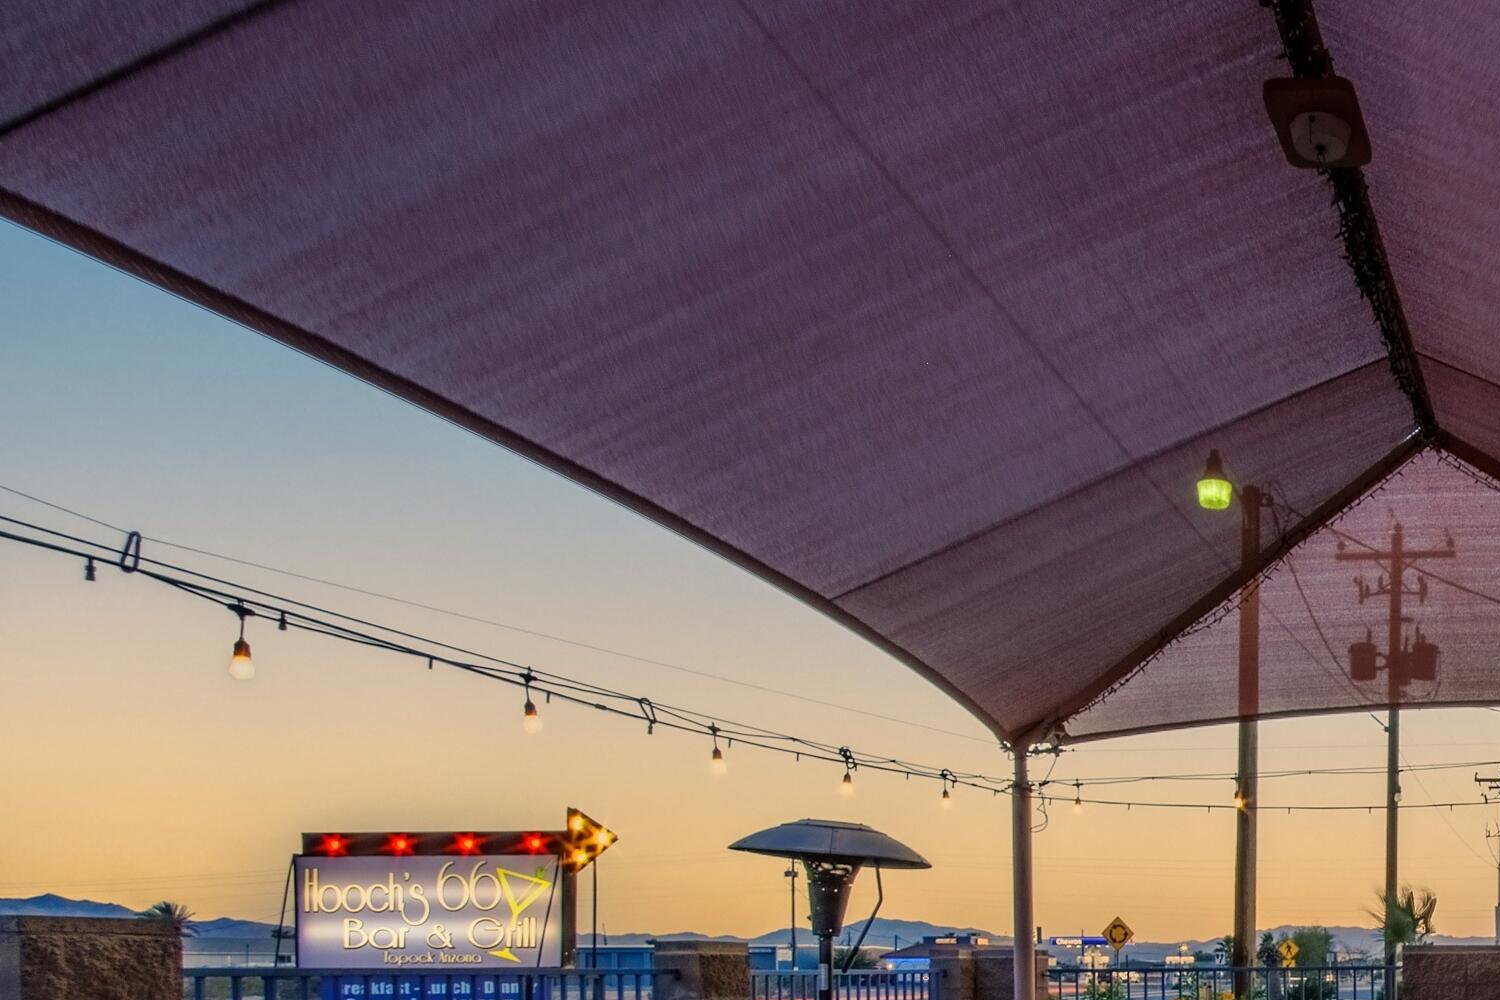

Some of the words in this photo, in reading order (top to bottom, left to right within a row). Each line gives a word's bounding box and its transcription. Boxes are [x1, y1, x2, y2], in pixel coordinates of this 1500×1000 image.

[304, 868, 430, 926] Hooch's
[437, 861, 502, 911] 66
[343, 918, 409, 949] Bar
[426, 923, 455, 949] &
[467, 917, 537, 949] Grill
[384, 951, 434, 967] Topock
[439, 951, 482, 964] Arizona
[341, 982, 411, 995] rekfat
